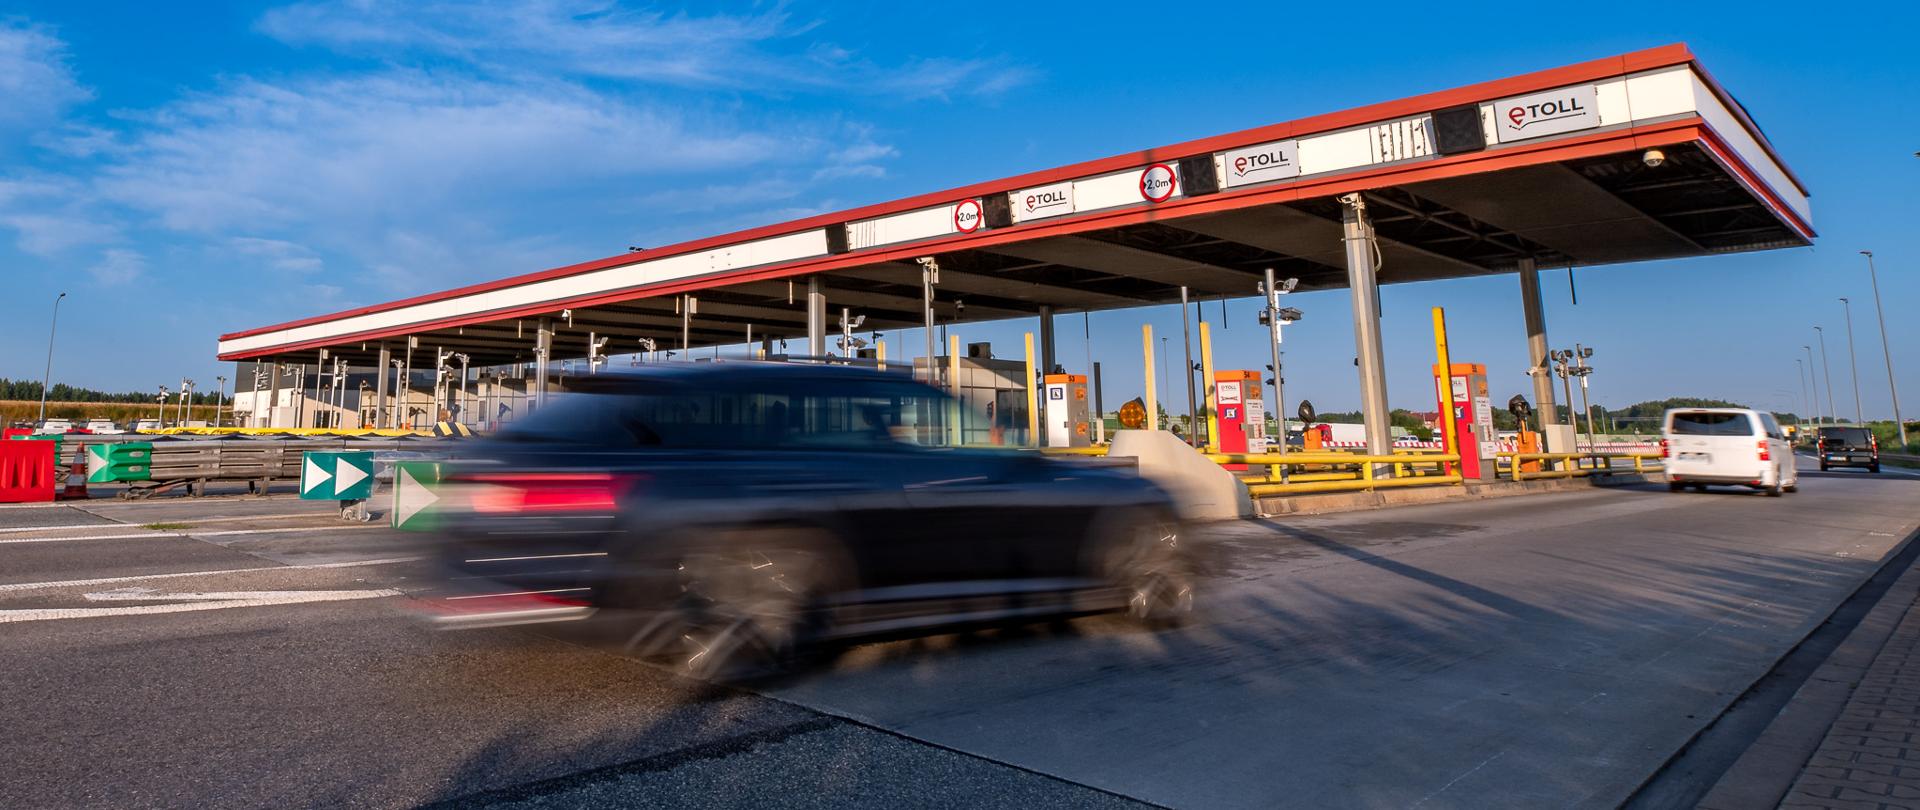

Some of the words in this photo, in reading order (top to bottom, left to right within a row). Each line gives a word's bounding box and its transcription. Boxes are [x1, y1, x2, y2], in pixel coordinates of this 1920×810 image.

[1509, 98, 1584, 125] eTOLL
[1235, 151, 1289, 173] eTOLL
[1027, 191, 1066, 209] eTOLL
